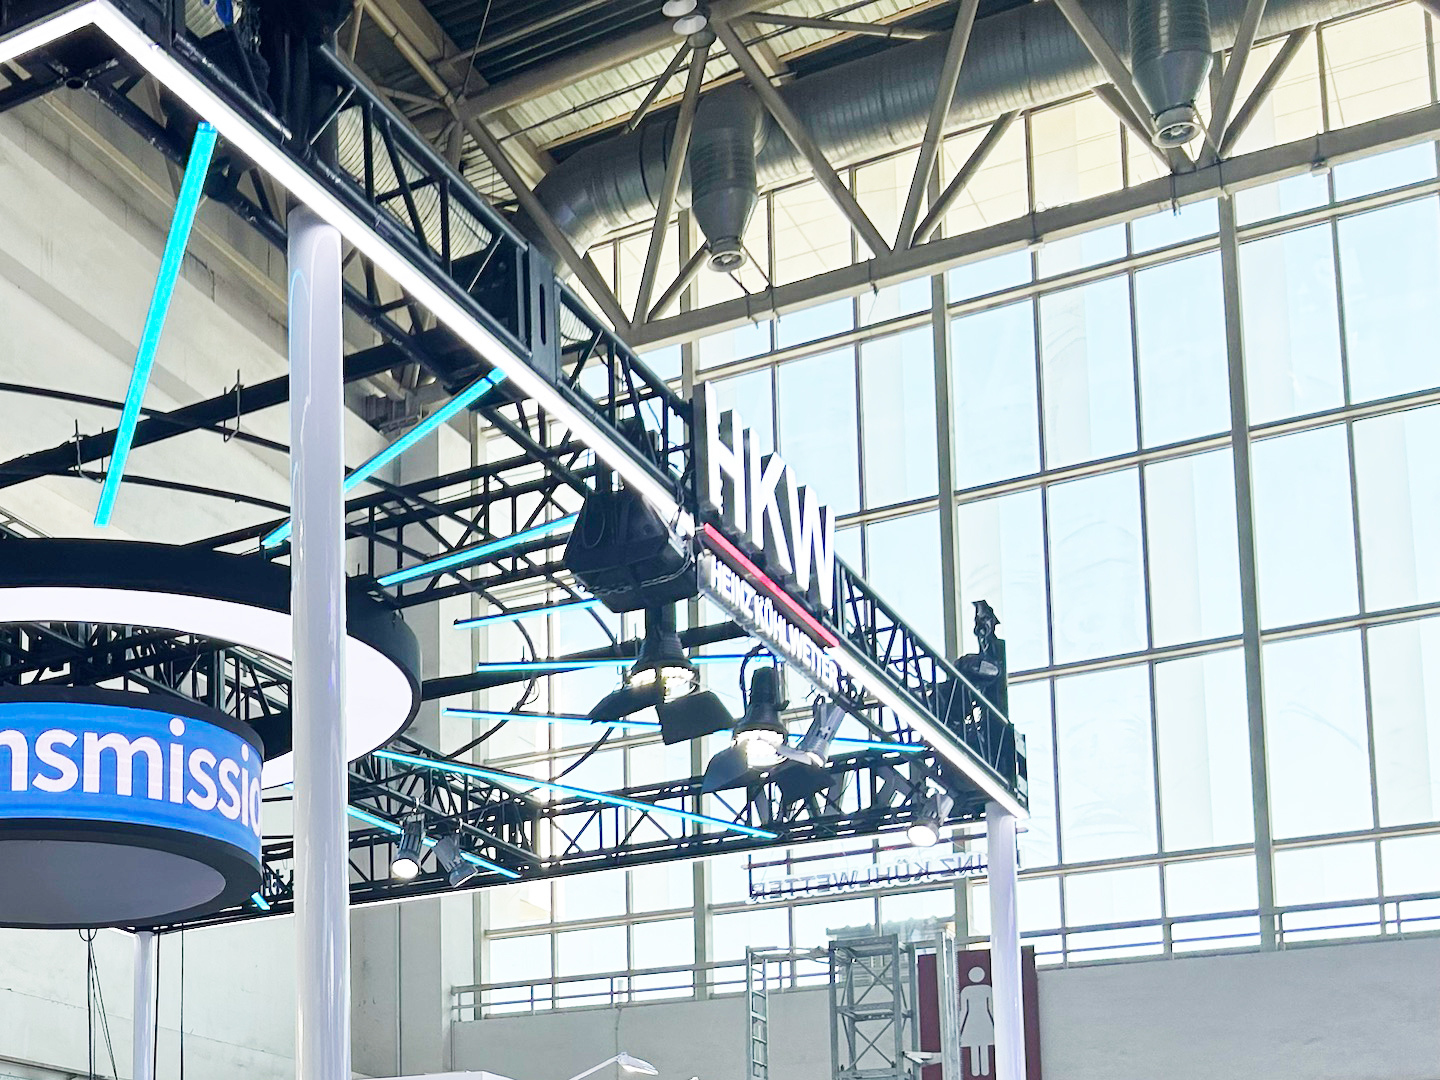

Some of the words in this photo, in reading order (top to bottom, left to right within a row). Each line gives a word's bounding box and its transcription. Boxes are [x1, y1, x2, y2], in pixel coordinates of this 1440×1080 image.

[704, 381, 835, 611] HKW
[711, 554, 757, 610] HEINZ
[754, 595, 839, 688] KÜHLWETTER
